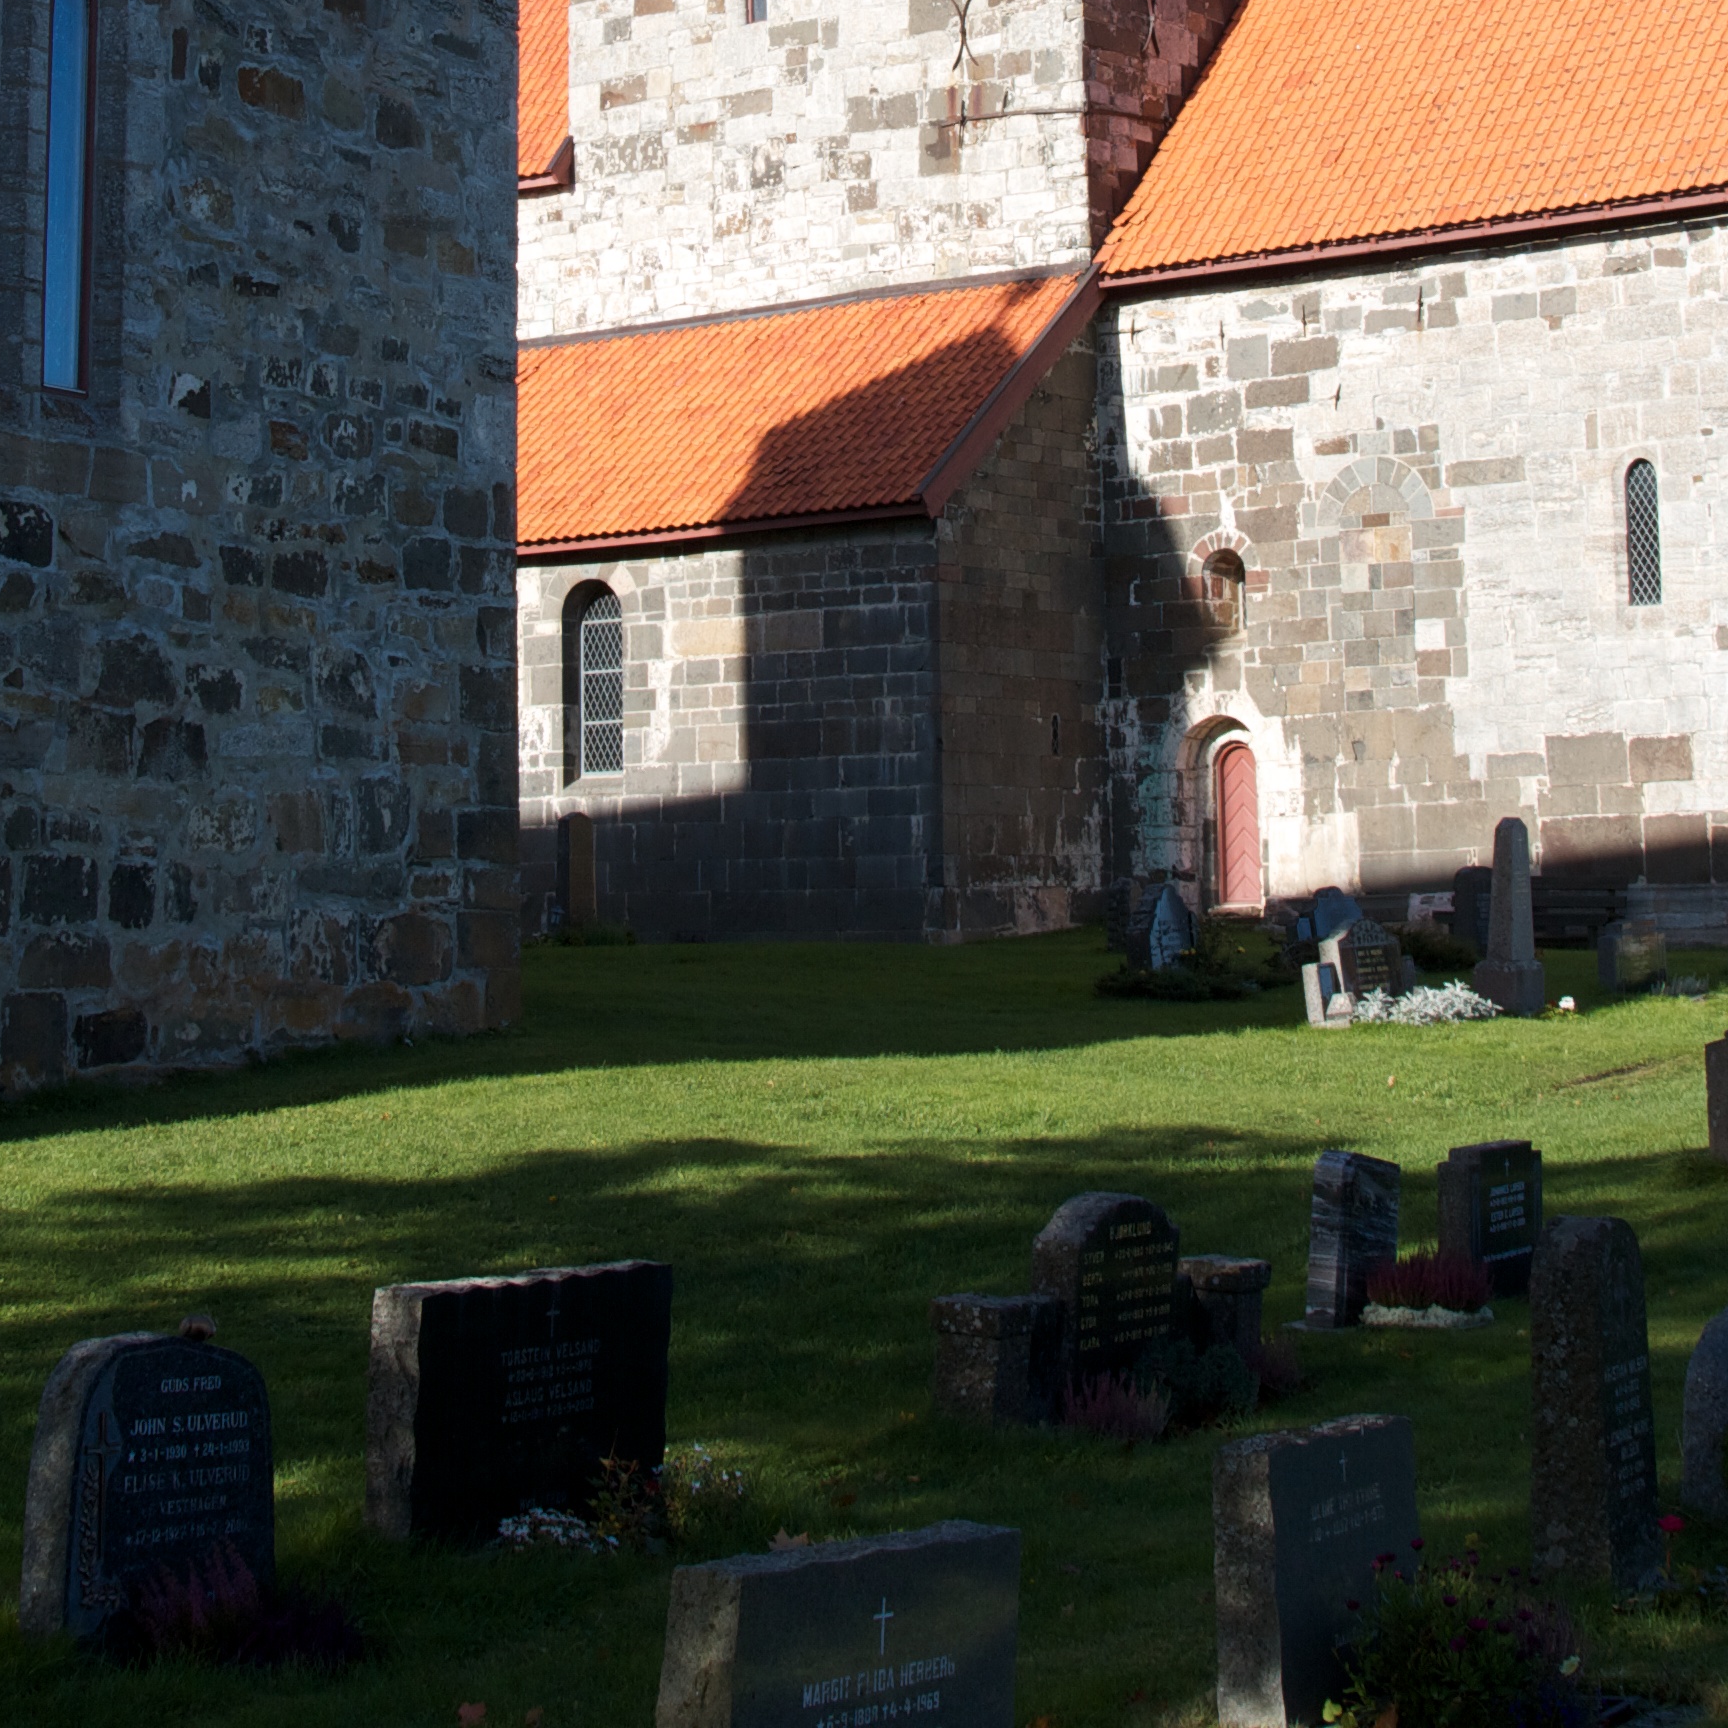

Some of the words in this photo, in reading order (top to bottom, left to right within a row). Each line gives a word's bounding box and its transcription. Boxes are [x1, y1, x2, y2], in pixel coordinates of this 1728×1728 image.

[500, 1346, 551, 1367] TORSTEIN
[555, 1337, 602, 1360] VELSAND
[160, 1377, 190, 1394] GUDS
[193, 1375, 222, 1391] FRED
[504, 1386, 545, 1408] ASLAUG
[548, 1378, 593, 1400] VELSAND
[129, 1416, 167, 1437] JOHN
[186, 1410, 249, 1433] ULVERUD
[123, 1472, 167, 1495] ELISE
[189, 1463, 251, 1488] ULVERUD
[802, 1674, 852, 1709] MARGIT
